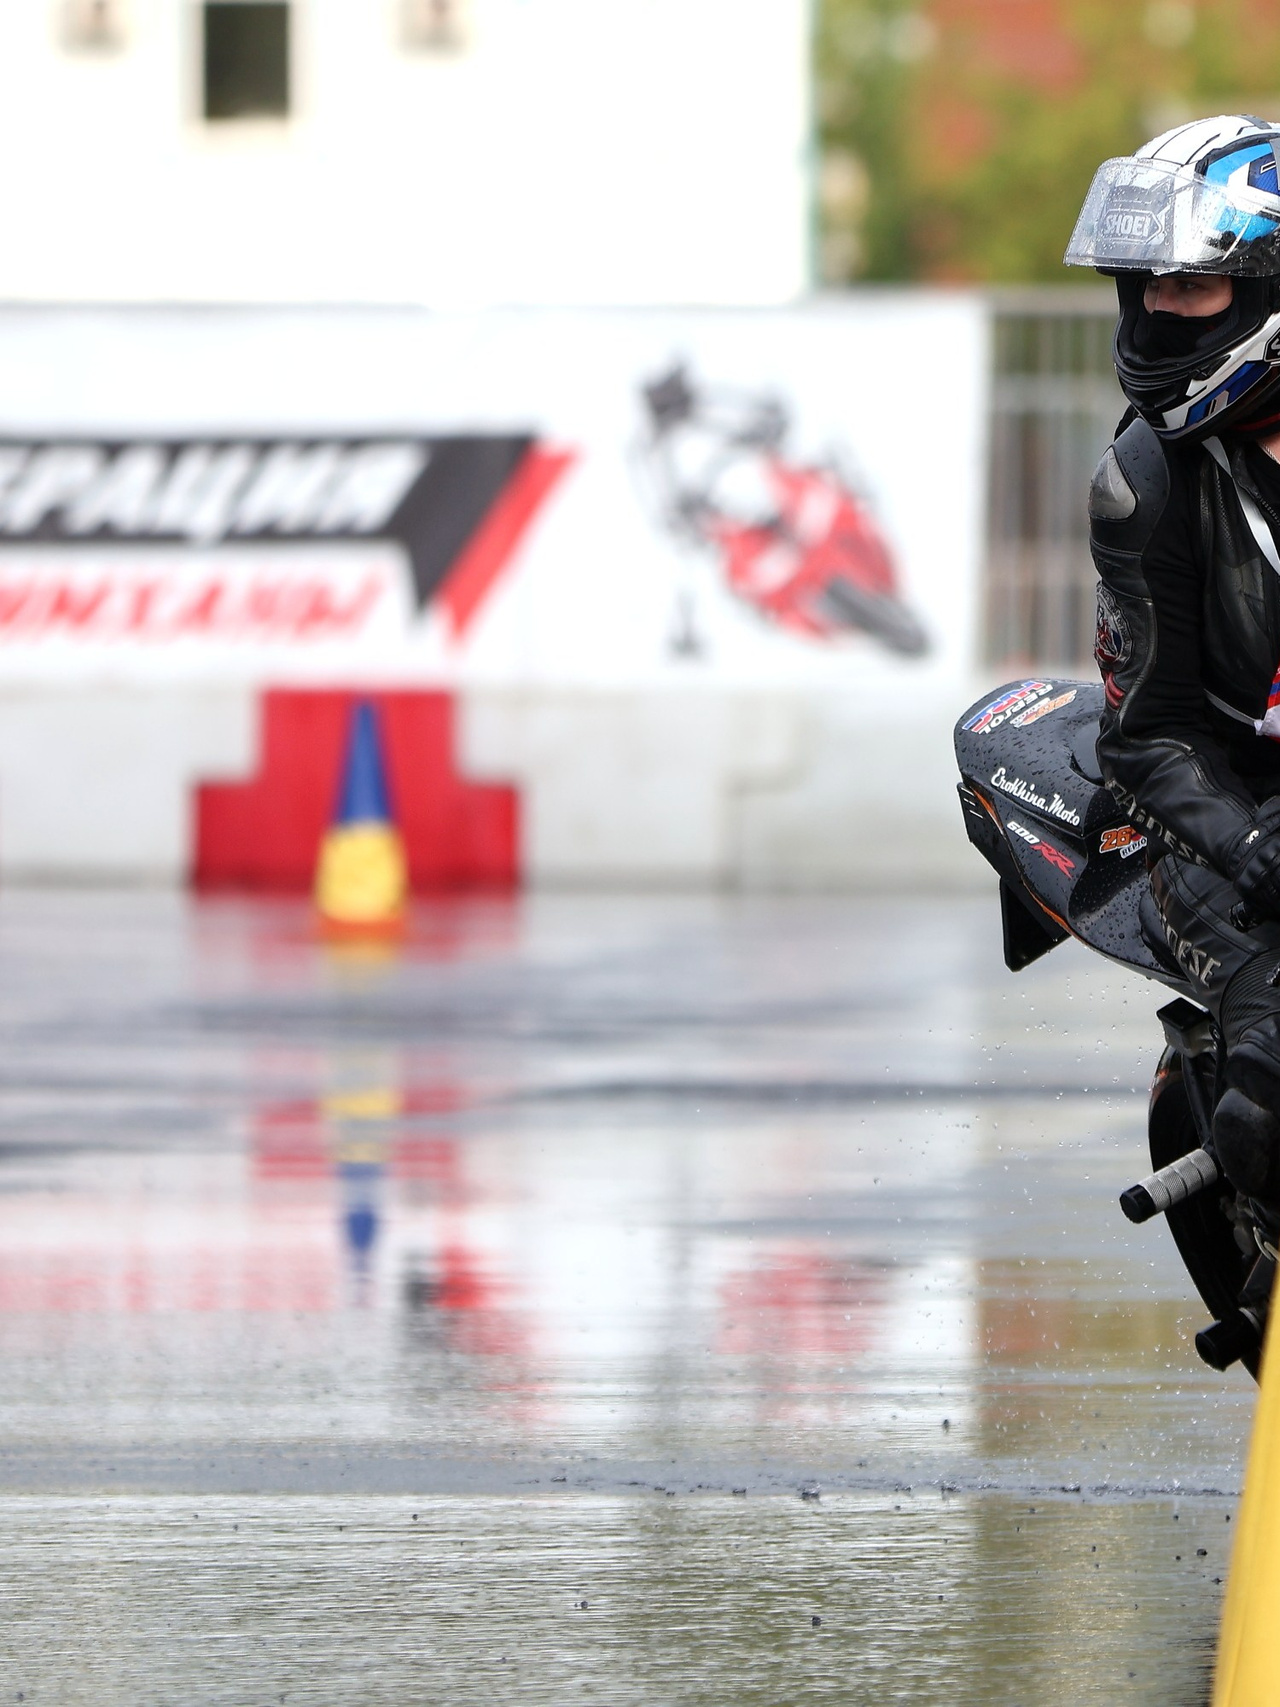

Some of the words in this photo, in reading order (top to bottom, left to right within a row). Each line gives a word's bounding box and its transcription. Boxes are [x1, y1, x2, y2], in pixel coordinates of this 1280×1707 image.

[1105, 214, 1151, 237] SHOEI
[979, 684, 1054, 734] REPSOL
[1101, 826, 1133, 853] 26
[1121, 837, 1143, 857] REPSO
